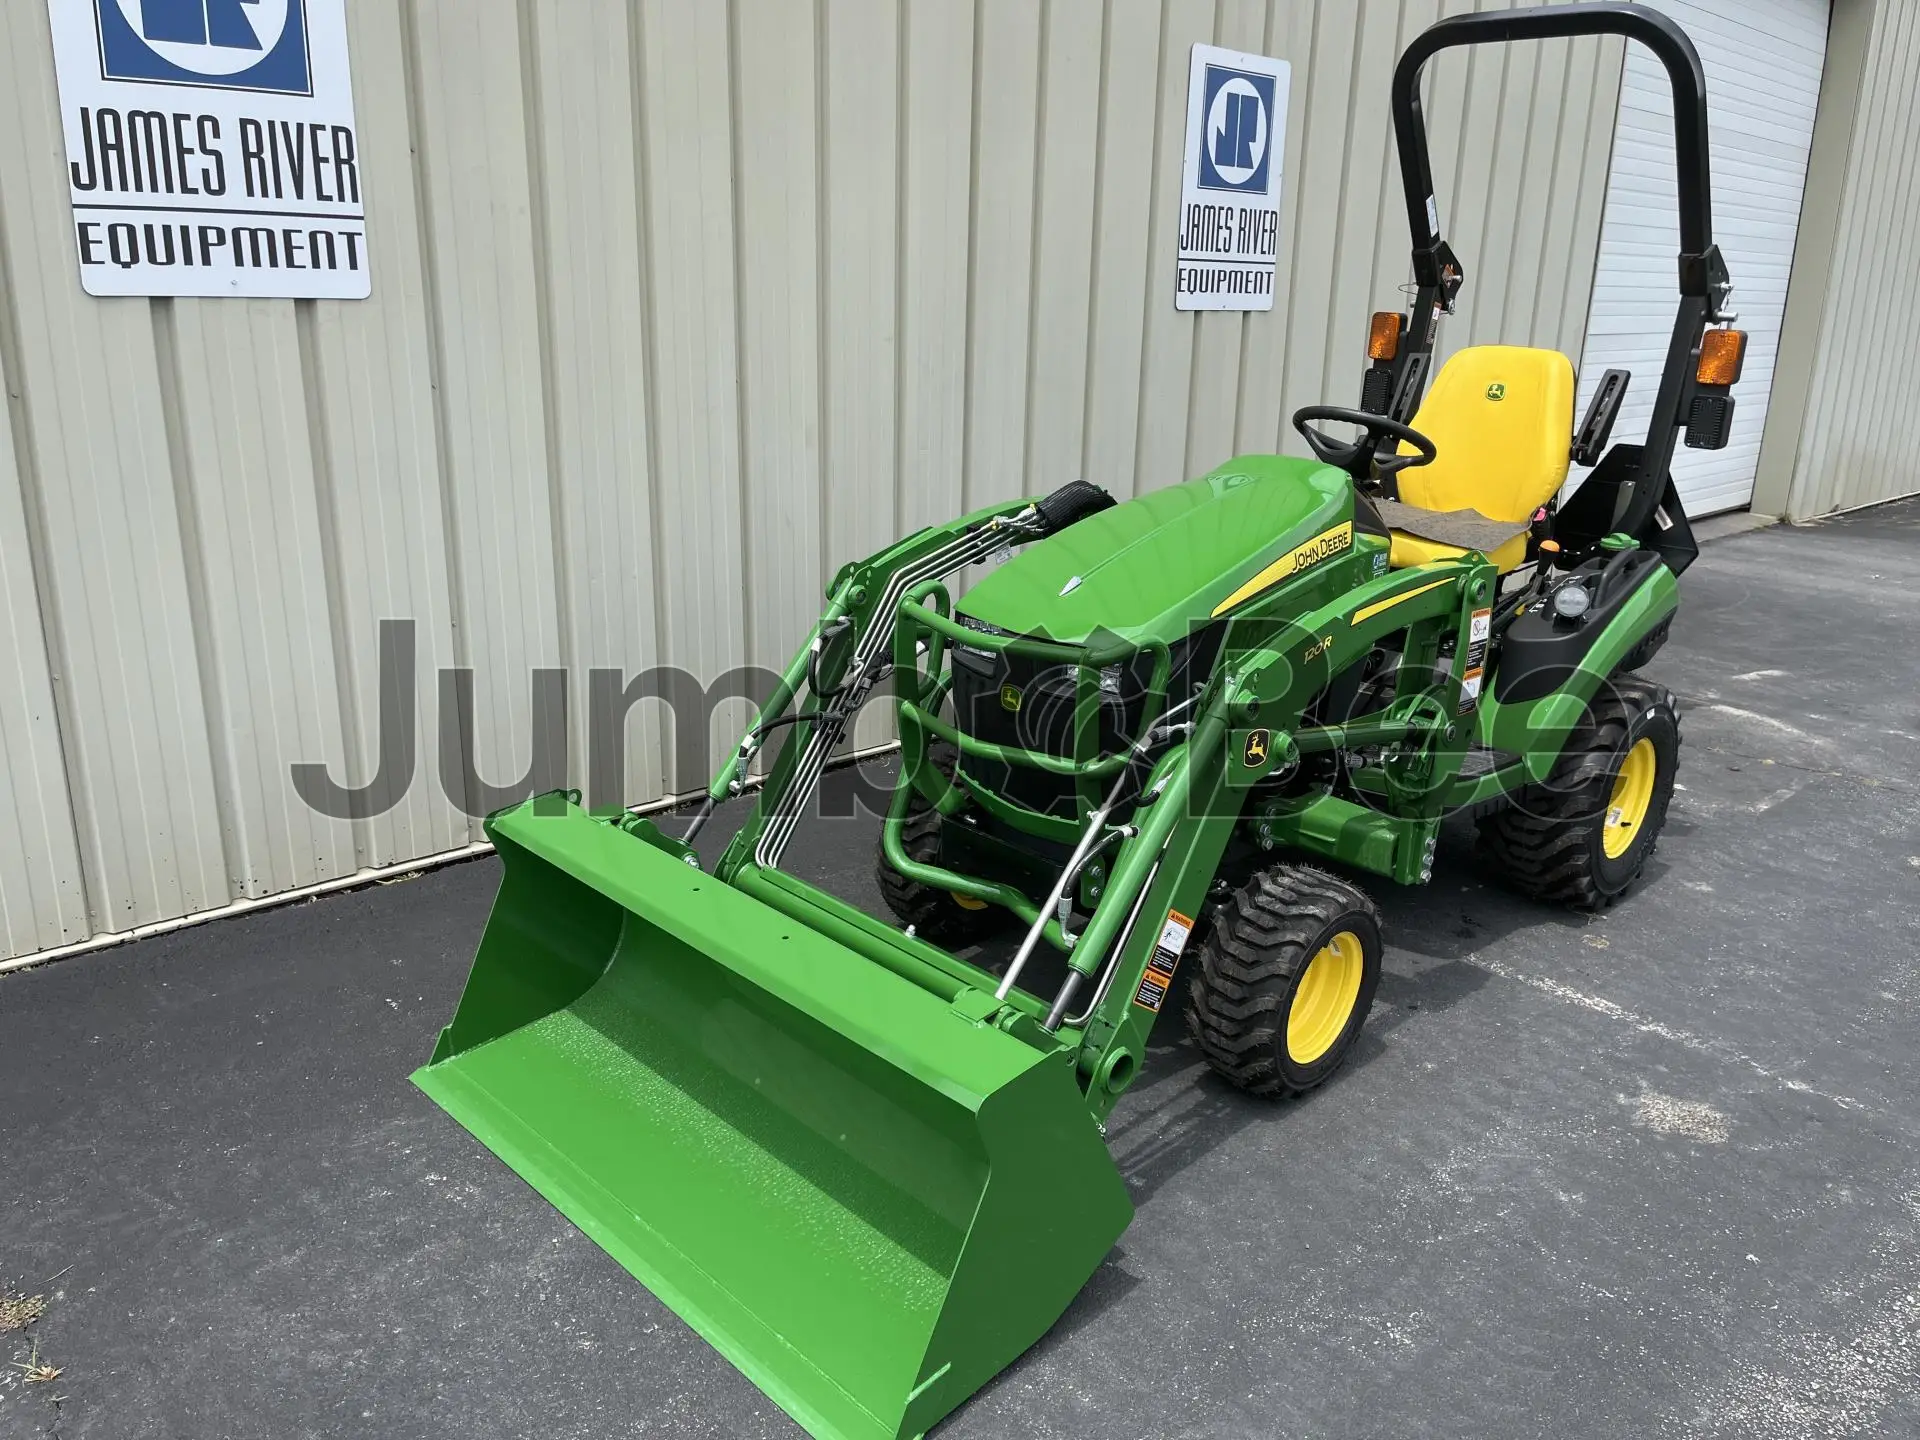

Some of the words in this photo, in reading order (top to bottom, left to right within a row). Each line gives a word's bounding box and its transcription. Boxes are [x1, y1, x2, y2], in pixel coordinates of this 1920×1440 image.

[71, 106, 227, 197] JAMES
[239, 117, 360, 204] RIVER
[77, 222, 363, 271] EQUIPMENT
[1180, 203, 1234, 253] JAMES
[1237, 207, 1278, 255] RIVER
[1177, 267, 1274, 295] EQUIPMENT
[1292, 544, 1320, 572] JOHN
[1320, 531, 1350, 556] DEERE
[1303, 634, 1333, 665] 120R
